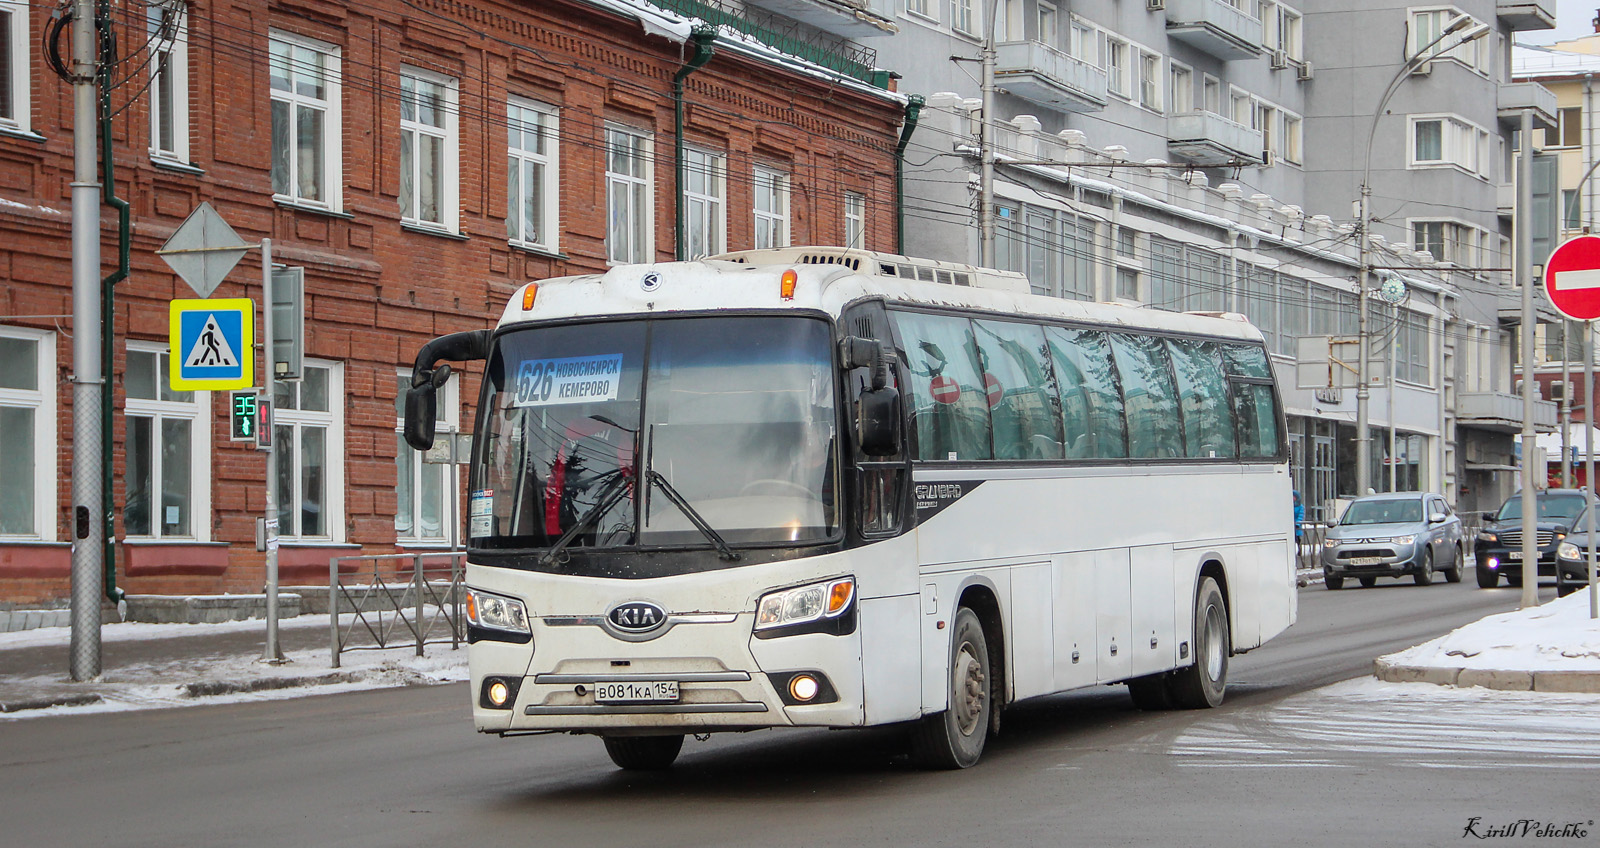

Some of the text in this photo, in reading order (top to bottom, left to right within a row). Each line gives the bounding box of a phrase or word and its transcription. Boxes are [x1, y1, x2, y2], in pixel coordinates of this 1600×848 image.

[518, 359, 619, 403] 626 НОВОСИБИРСК
[559, 379, 610, 398] КЕМЕРОВО
[235, 396, 256, 416] 35
[616, 608, 656, 625] KIA
[599, 684, 652, 699] В081КА
